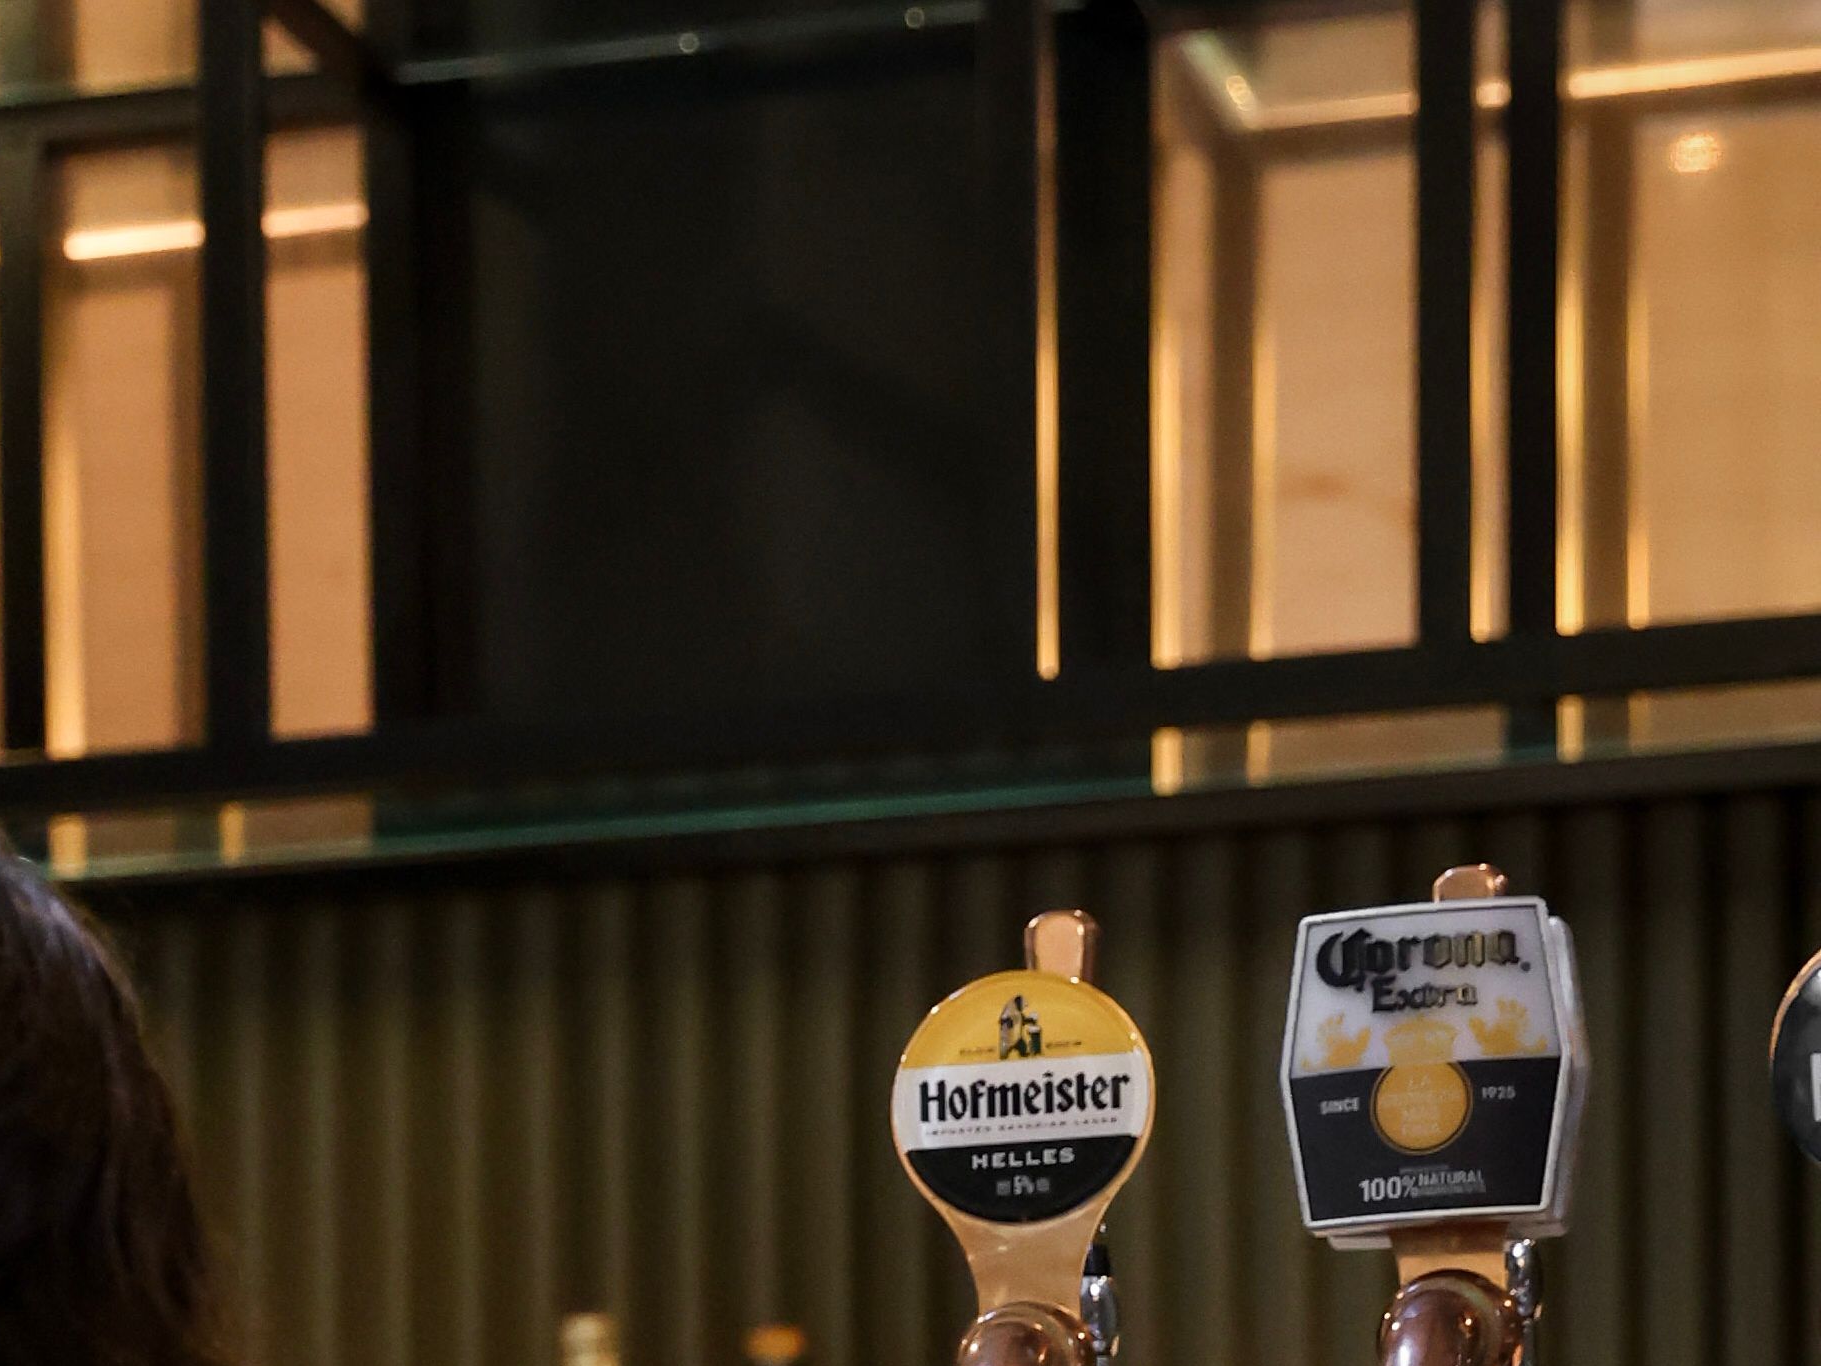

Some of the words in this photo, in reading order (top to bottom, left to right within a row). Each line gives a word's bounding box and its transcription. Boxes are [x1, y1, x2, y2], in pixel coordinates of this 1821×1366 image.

[1316, 927, 1522, 993] Corona
[1372, 976, 1479, 1014] Extra
[919, 1069, 1131, 1123] Hofmeister
[1481, 1085, 1517, 1100] 1925
[971, 1146, 1076, 1170] HELLES
[1358, 1174, 1419, 1202] 100%
[1417, 1169, 1485, 1187] NATURAL
